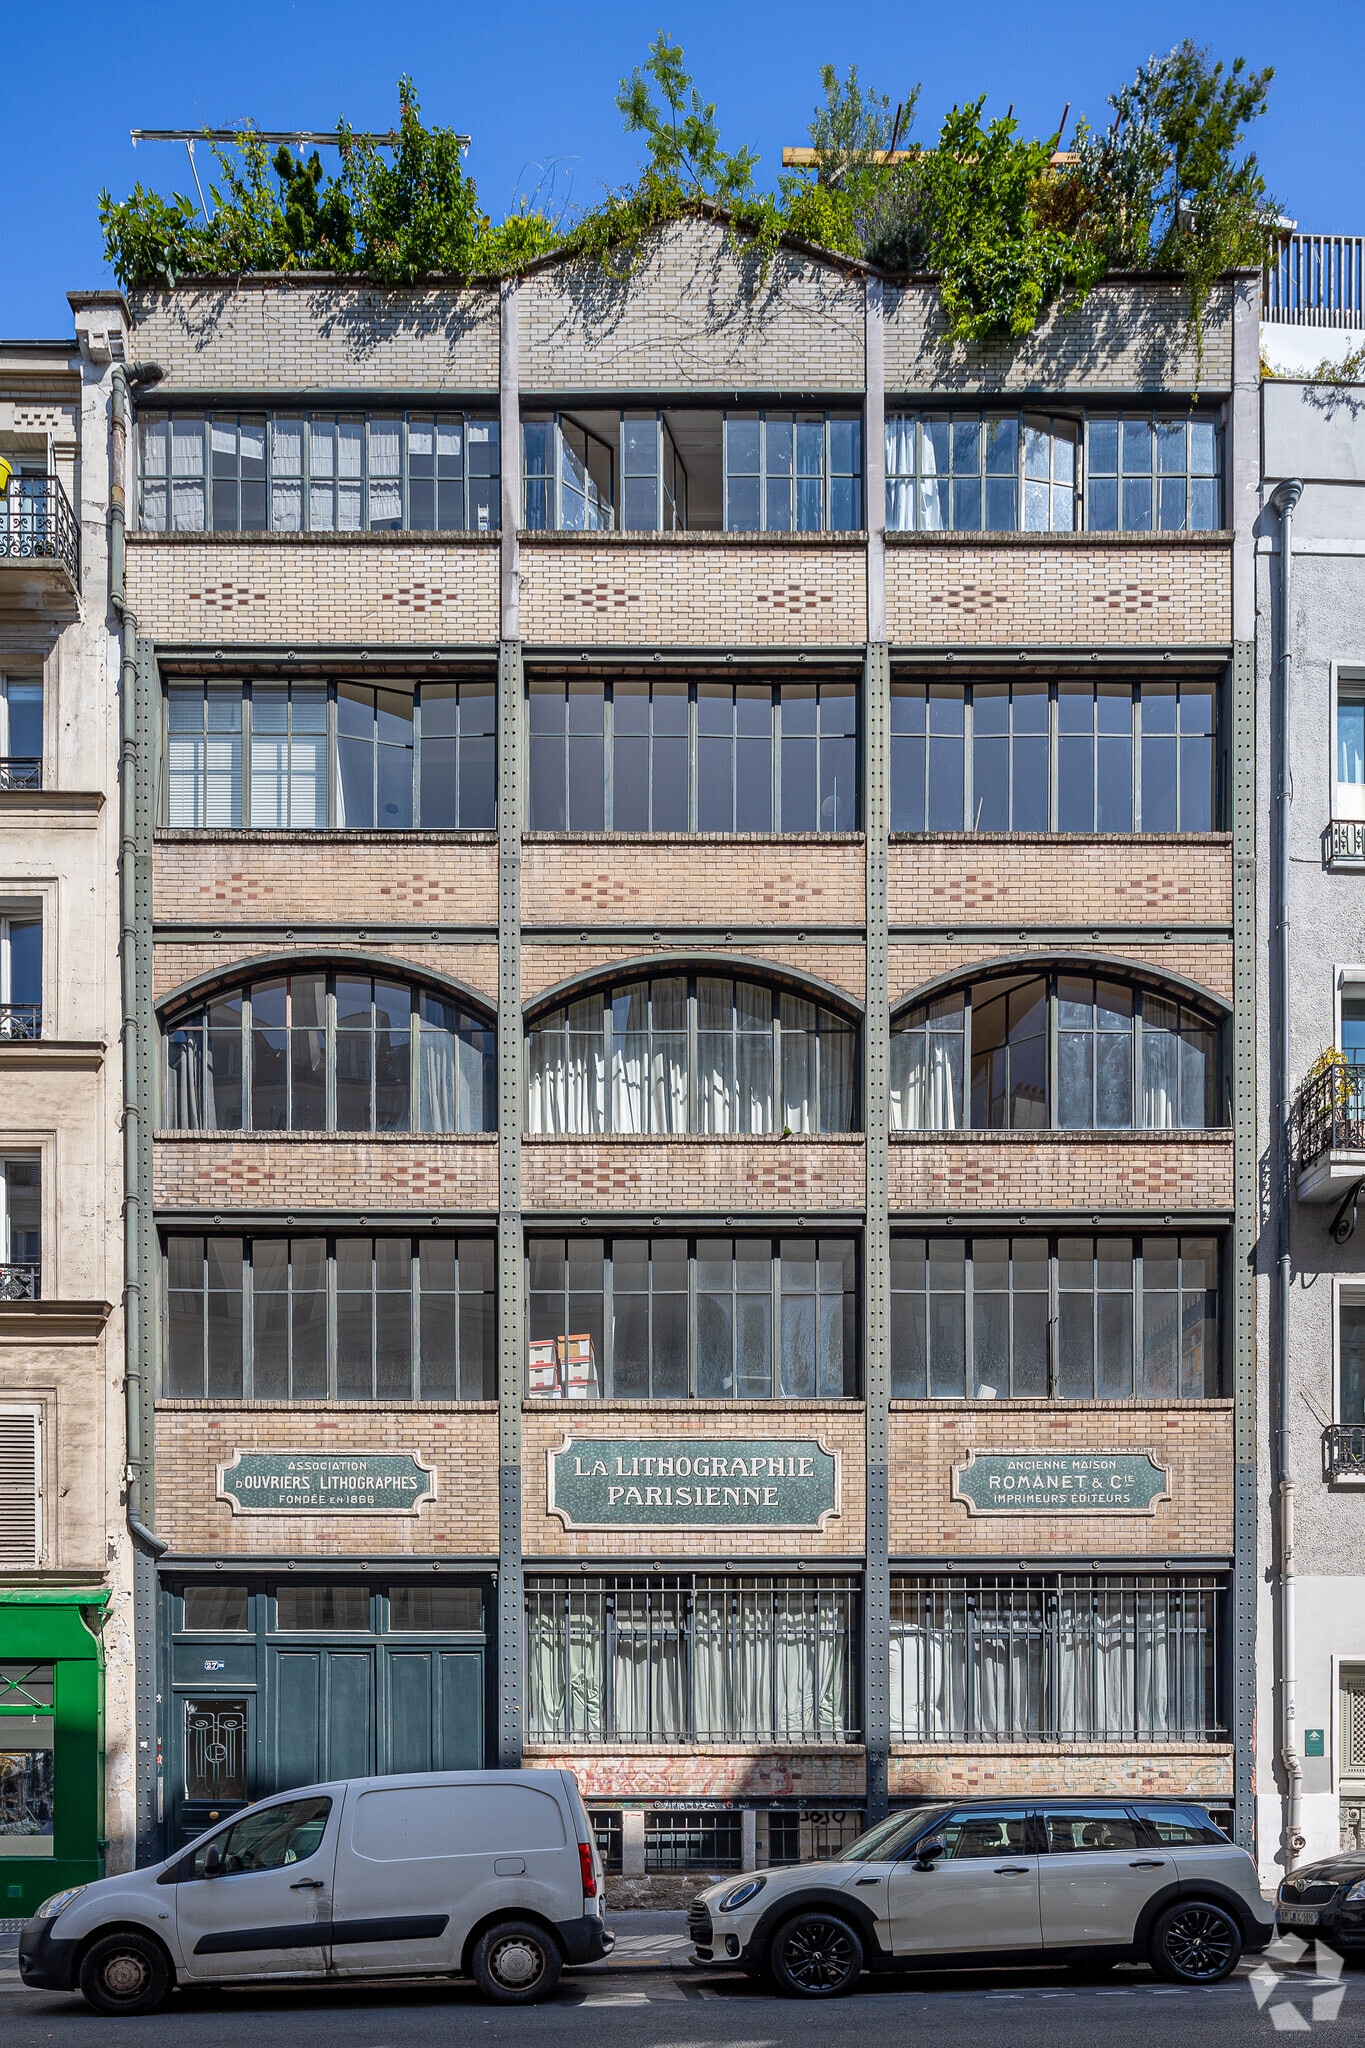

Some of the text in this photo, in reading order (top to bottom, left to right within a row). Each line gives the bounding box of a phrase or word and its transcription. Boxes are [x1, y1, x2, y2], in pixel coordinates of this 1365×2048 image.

[288, 1461, 367, 1471] ASSOCIATION
[574, 1457, 815, 1477] LA LITHOGRAPHIE
[1007, 1460, 1117, 1470] ANCIENNE MAISON
[235, 1476, 418, 1490] D'OUVRIERS LITHOGRAPHES
[989, 1475, 1087, 1489] ROMANET
[1092, 1477, 1102, 1488] &
[279, 1494, 326, 1504] FONDÉE
[346, 1496, 375, 1504] 1866
[607, 1486, 779, 1506] PARISIENNE
[994, 1491, 1131, 1503] IMPRIMEURS ÉDITEURS
